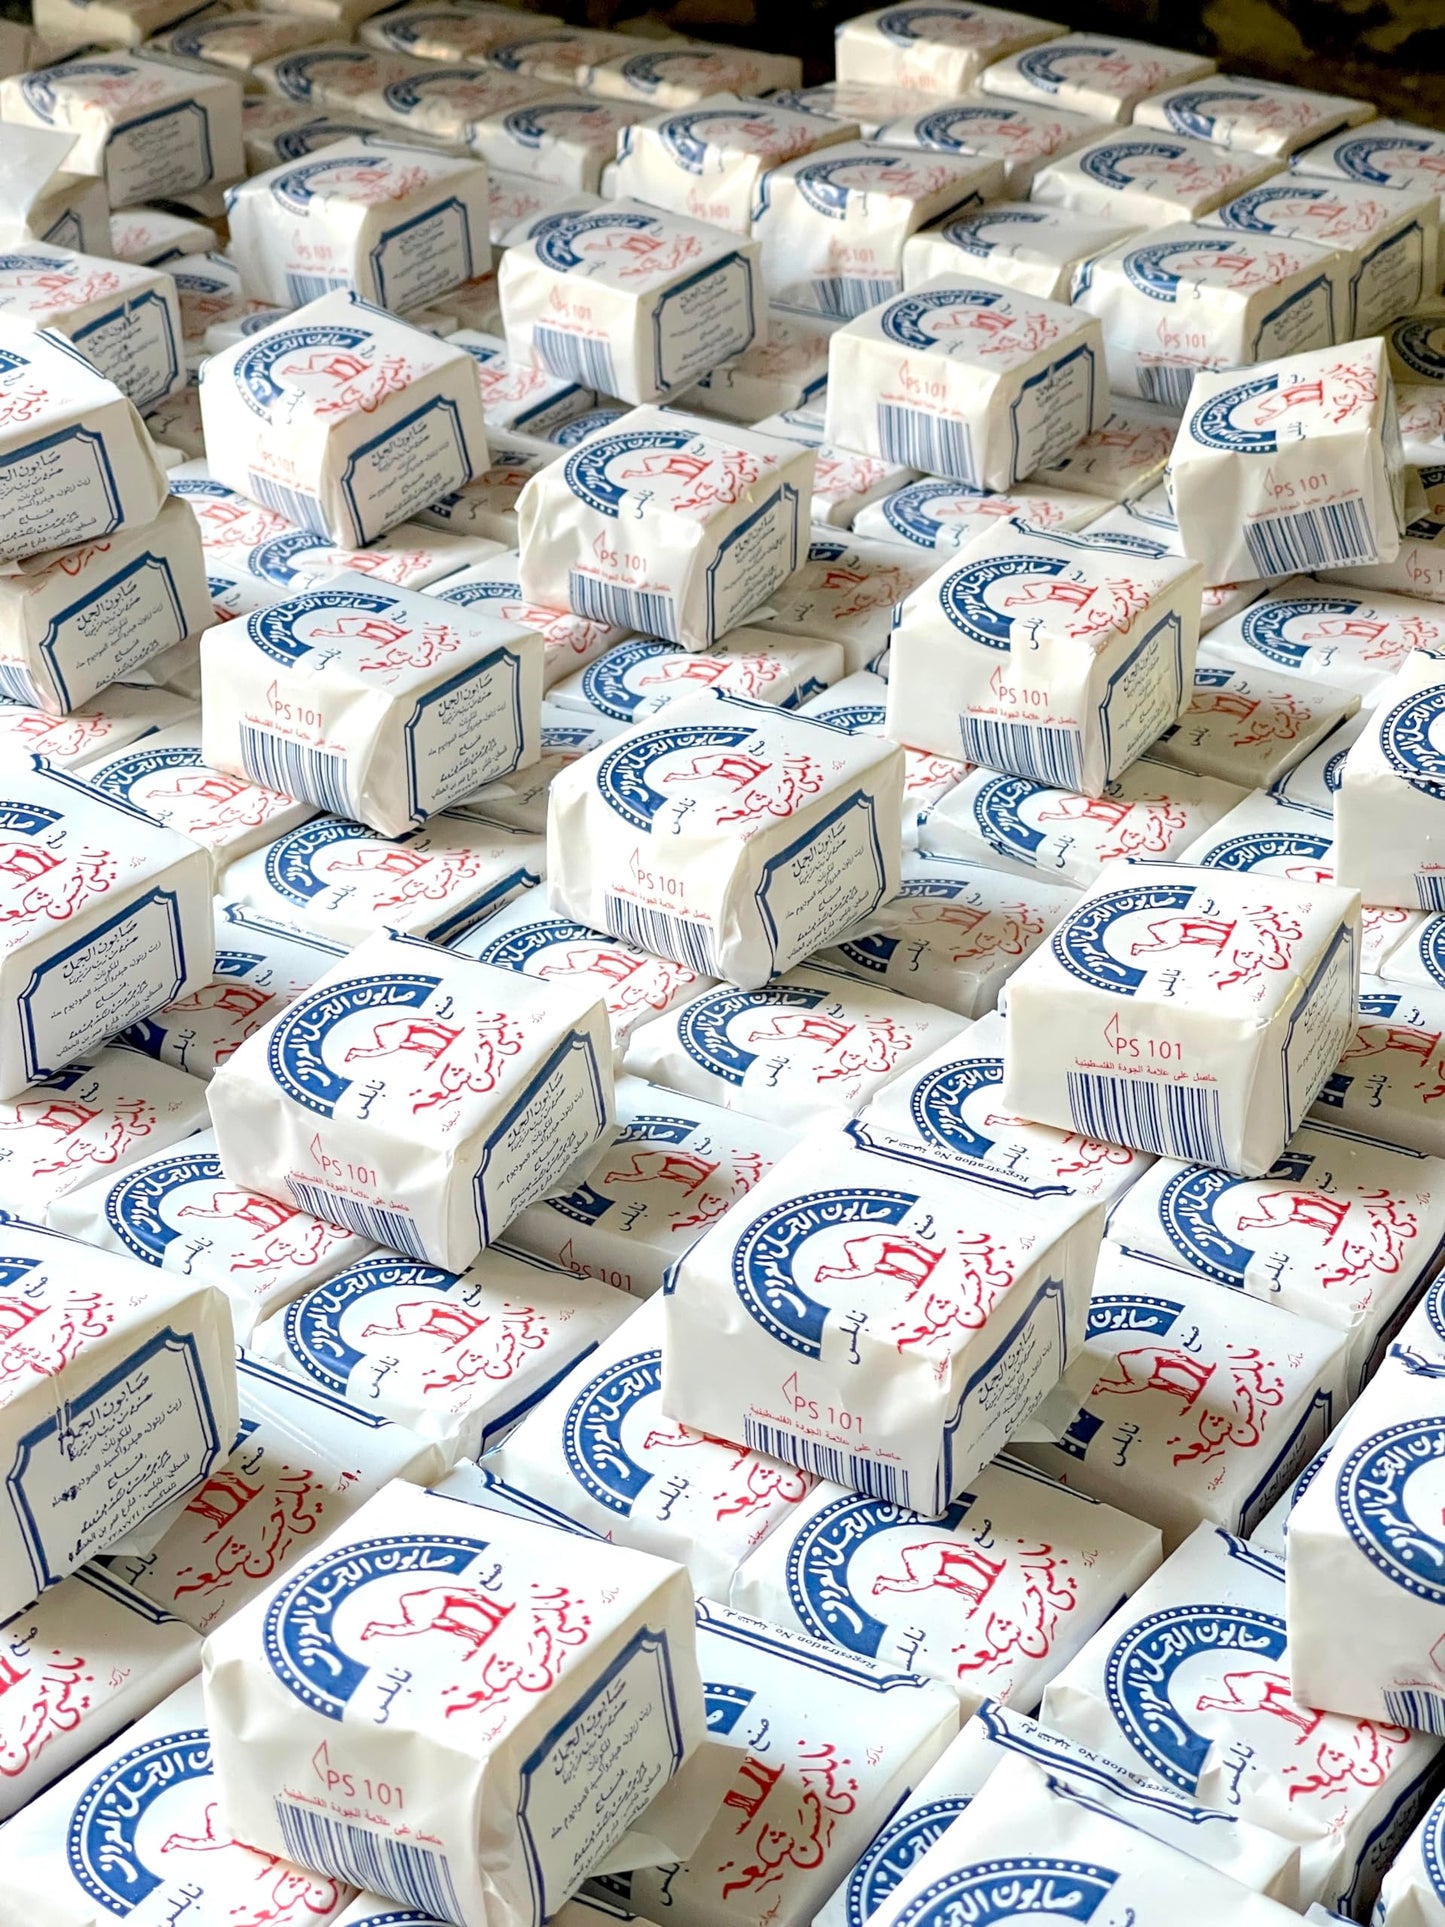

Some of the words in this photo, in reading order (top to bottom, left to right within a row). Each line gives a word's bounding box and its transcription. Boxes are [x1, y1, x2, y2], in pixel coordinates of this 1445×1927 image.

[1164, 333, 1180, 348] PS
[1185, 333, 1207, 349] 101
[906, 377, 921, 394] PS
[924, 381, 947, 400] 101
[1274, 480, 1295, 499] PS
[1299, 471, 1328, 492] 101
[600, 550, 618, 568] PS
[624, 553, 647, 573] 101
[1000, 562, 1051, 572] صابون
[1414, 569, 1433, 583] PS
[105, 581, 137, 610] صابون
[323, 598, 377, 608] صابون
[1024, 617, 1045, 649] نابلس
[315, 648, 341, 670] نابلس
[464, 674, 492, 700] صابون
[997, 687, 1017, 704] PS
[1022, 689, 1049, 707] 101
[275, 701, 292, 720] PS
[298, 707, 321, 728] 101
[627, 738, 674, 768] الجمل
[677, 734, 732, 746] صابون
[749, 741, 765, 756] صنع
[671, 799, 697, 834] نابلس
[818, 822, 845, 854] صابون
[638, 870, 655, 888] PS
[660, 876, 683, 897] 101
[1115, 895, 1176, 910] صابون
[1198, 900, 1221, 916] صنع
[1071, 905, 1118, 940] الجمل
[98, 920, 138, 954] صابون
[352, 987, 416, 1005] صابون
[1160, 968, 1186, 1001] نابلس
[435, 997, 454, 1019] صنع
[702, 996, 749, 1025] الجمل
[749, 994, 807, 1005] صابون
[826, 1004, 844, 1018] صنع
[298, 996, 351, 1040] الجمل
[1116, 1038, 1140, 1057] PS
[1149, 1041, 1181, 1060] 101
[767, 1056, 791, 1085] نابلس
[1075, 1057, 1114, 1069] الفلسطينية
[1118, 1063, 1143, 1074] الجودة
[1147, 1066, 1169, 1076] علامة
[1174, 1072, 1188, 1081] على
[1193, 1073, 1217, 1082] حاصل
[357, 1079, 386, 1121] نابلس
[533, 1073, 565, 1114] صابون
[321, 1156, 343, 1176] PS
[348, 1164, 376, 1186] 101
[821, 1202, 891, 1221] صابون
[762, 1209, 819, 1258] الجمل
[913, 1215, 936, 1239] صنع
[379, 1269, 445, 1284] صابون
[601, 1268, 632, 1291] 101
[320, 1272, 377, 1312] الجمل
[463, 1287, 482, 1307] صنع
[1089, 1309, 1159, 1329] صابون
[844, 1310, 868, 1365] نابلس
[1180, 1327, 1202, 1353] صنع
[366, 1356, 400, 1394] نابلس
[103, 1373, 149, 1417] صابون
[793, 1394, 820, 1420] PS
[829, 1407, 861, 1433] 101
[1112, 1422, 1142, 1468] نابلس
[817, 1508, 875, 1565] الجمل
[971, 1520, 994, 1548] صنع
[375, 1549, 455, 1571] صابون
[304, 1558, 372, 1614] الجمل
[478, 1564, 502, 1591] صنع
[374, 1668, 413, 1724] نابلس
[328, 1770, 356, 1797] PS
[365, 1779, 403, 1809] 101
